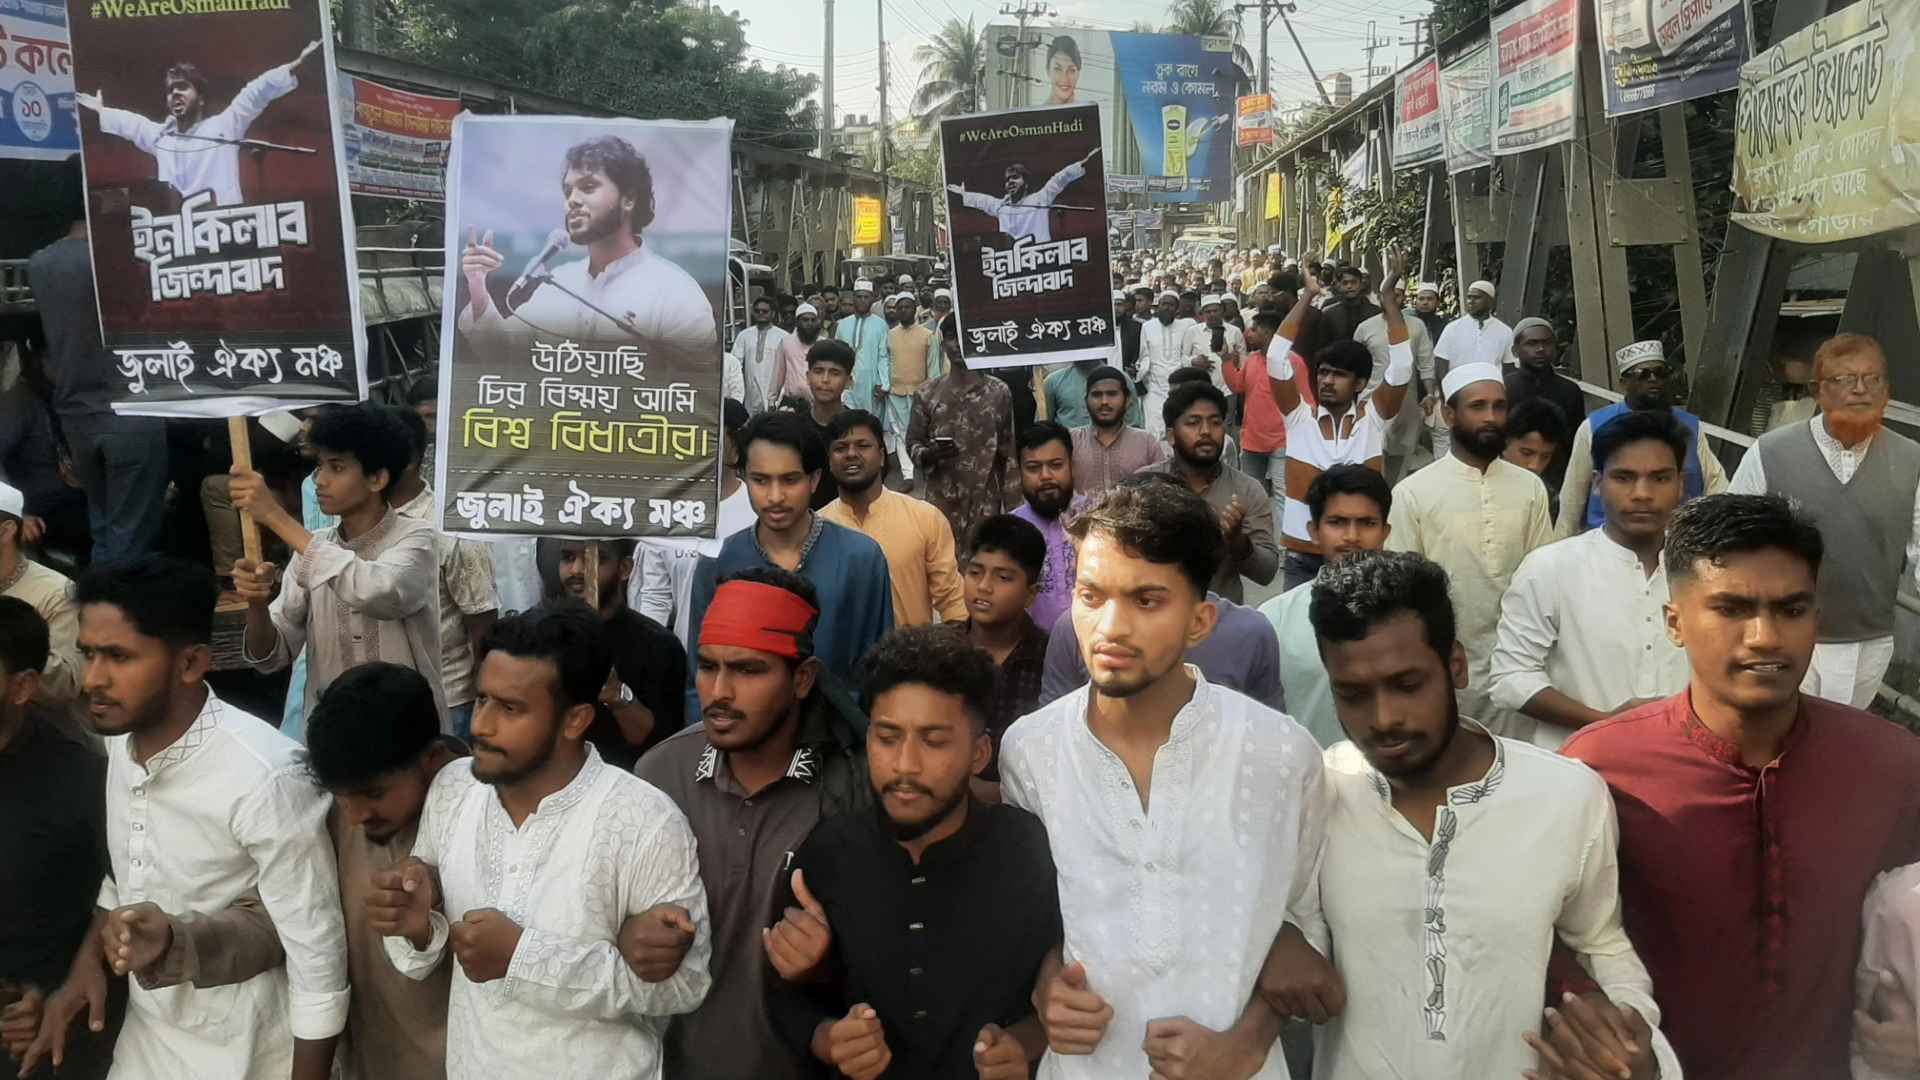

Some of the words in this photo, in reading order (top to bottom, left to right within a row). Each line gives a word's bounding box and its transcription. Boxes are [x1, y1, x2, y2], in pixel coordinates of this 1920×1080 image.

[959, 119, 1083, 143] #WeAreOsmanHadi
[130, 191, 309, 262] ইনকিলাব
[981, 235, 1088, 278] ইনকিলাব
[150, 254, 285, 302] জিন্দাবাদ
[992, 267, 1074, 300] জিন্দাবাদ
[968, 320, 1019, 351] জুলাই
[1026, 317, 1071, 341] ঐক্য
[1077, 316, 1107, 336] মঞ্চ
[113, 341, 195, 393] জুলাই
[206, 338, 282, 384] ঐক্য
[292, 343, 343, 379] মঞ্চ
[531, 340, 648, 380] উঠিয়াছি
[478, 375, 527, 410] চির
[539, 378, 621, 414] বিস্ময়
[633, 383, 698, 413] আমি
[463, 408, 534, 450] বিশ্ব
[456, 484, 545, 529] জুলাই
[558, 480, 635, 530] ঐক্য
[648, 497, 706, 528] মঞ্চ
